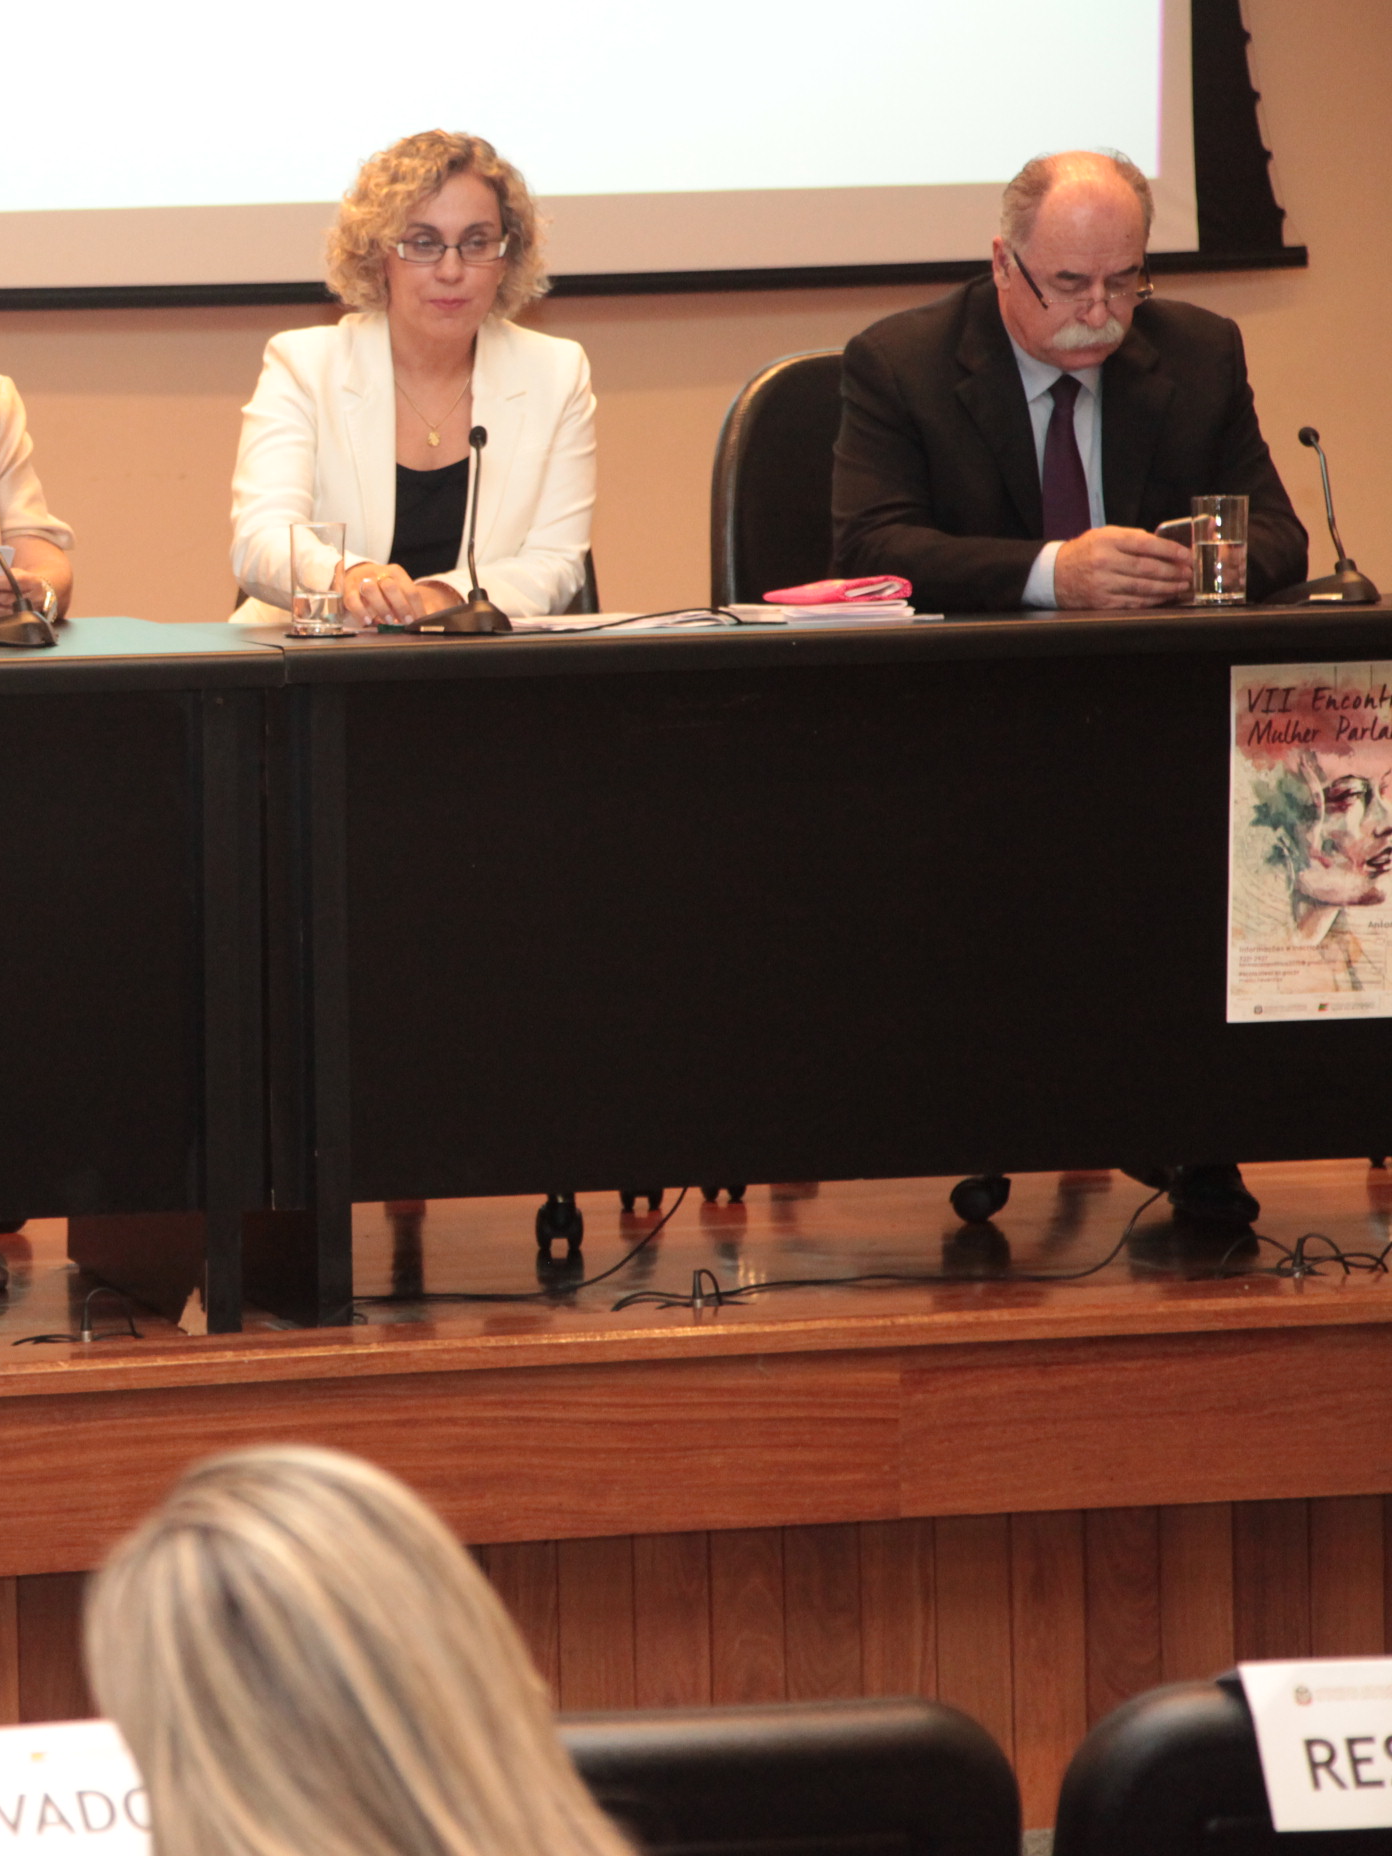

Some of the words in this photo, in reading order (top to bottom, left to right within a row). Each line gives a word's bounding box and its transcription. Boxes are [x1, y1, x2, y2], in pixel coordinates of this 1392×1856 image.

[1247, 686, 1296, 714] VII
[1247, 718, 1321, 747] Mulher
[1304, 1735, 1392, 1791] RE
